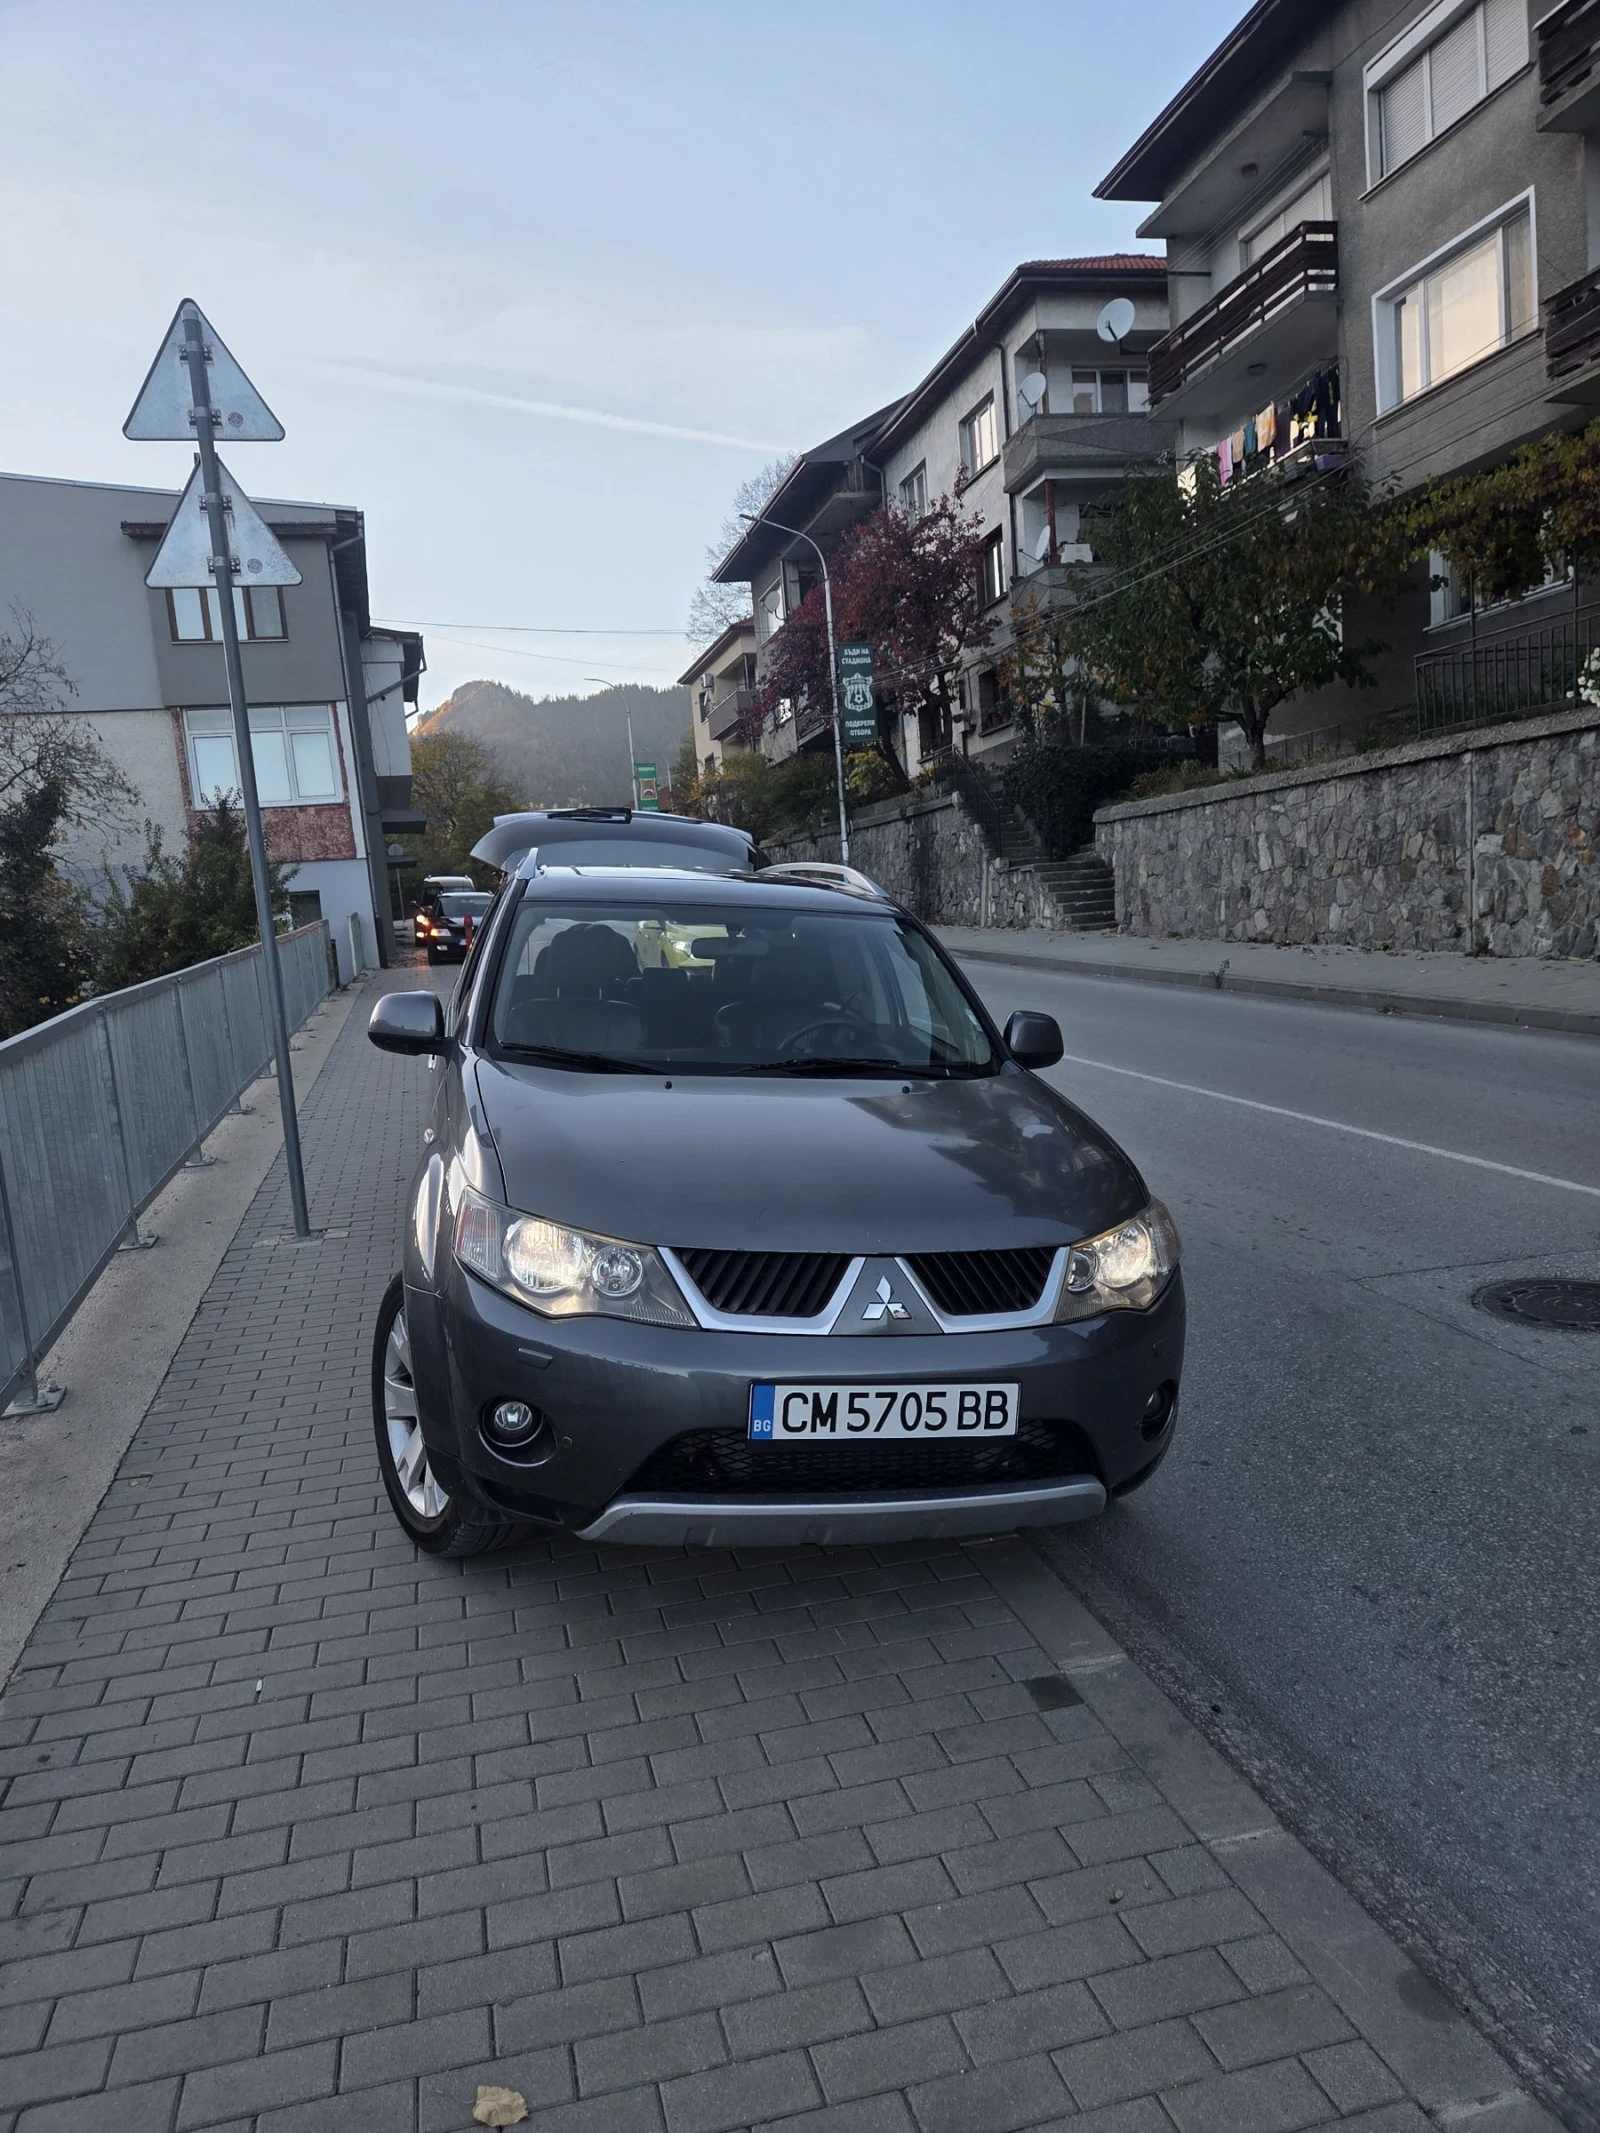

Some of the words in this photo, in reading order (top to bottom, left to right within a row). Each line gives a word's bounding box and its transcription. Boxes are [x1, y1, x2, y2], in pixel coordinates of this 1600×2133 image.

[844, 648, 860, 656] БЪДИ
[861, 647, 869, 655] НА
[842, 656, 871, 665] СТАДИОНА
[845, 719, 875, 728] ПОДКРЕПИ
[753, 1419, 771, 1432] BG
